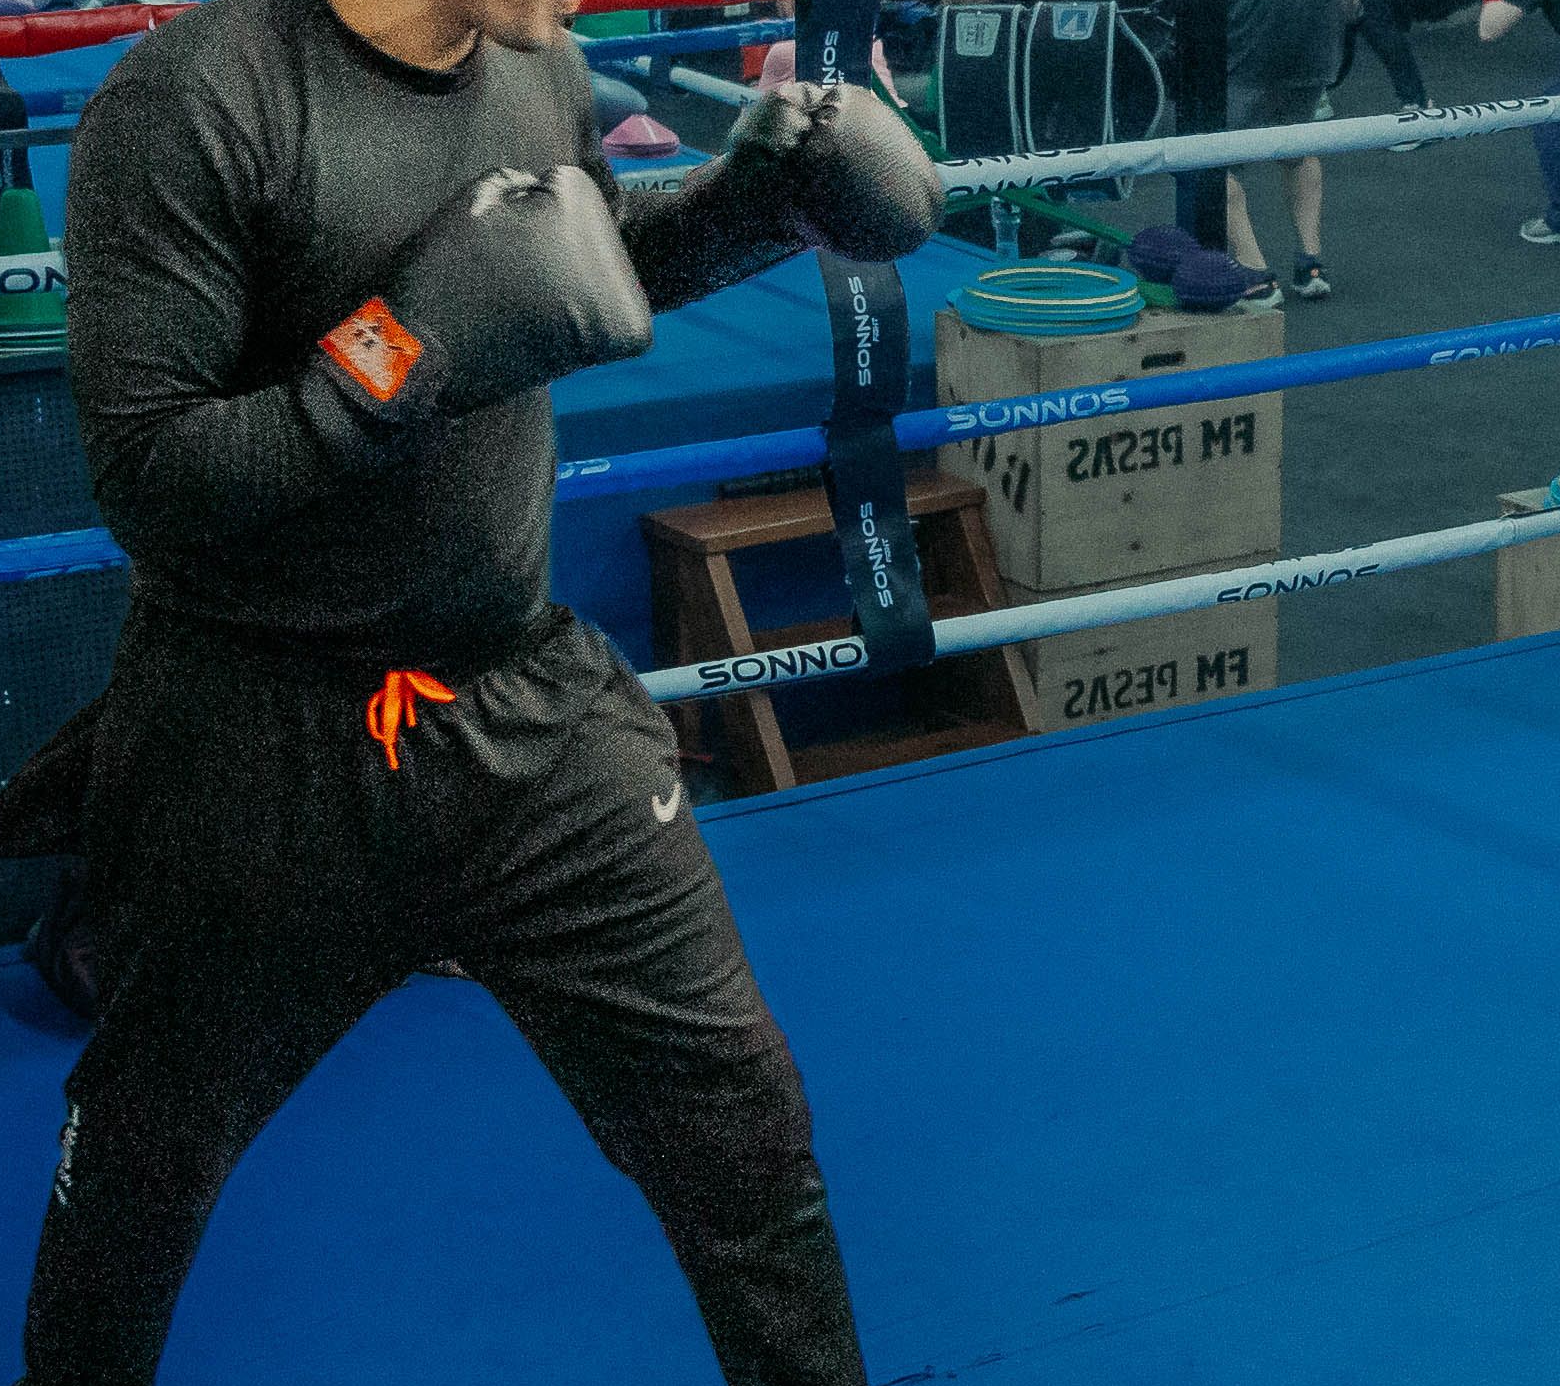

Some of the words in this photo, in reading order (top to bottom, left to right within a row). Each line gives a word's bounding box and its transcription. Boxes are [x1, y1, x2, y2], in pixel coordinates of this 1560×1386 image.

[847, 276, 872, 386] SONNOS
[947, 387, 1130, 432] SONNOS
[860, 501, 894, 608] SONNOS
[698, 642, 864, 690] SONNO
